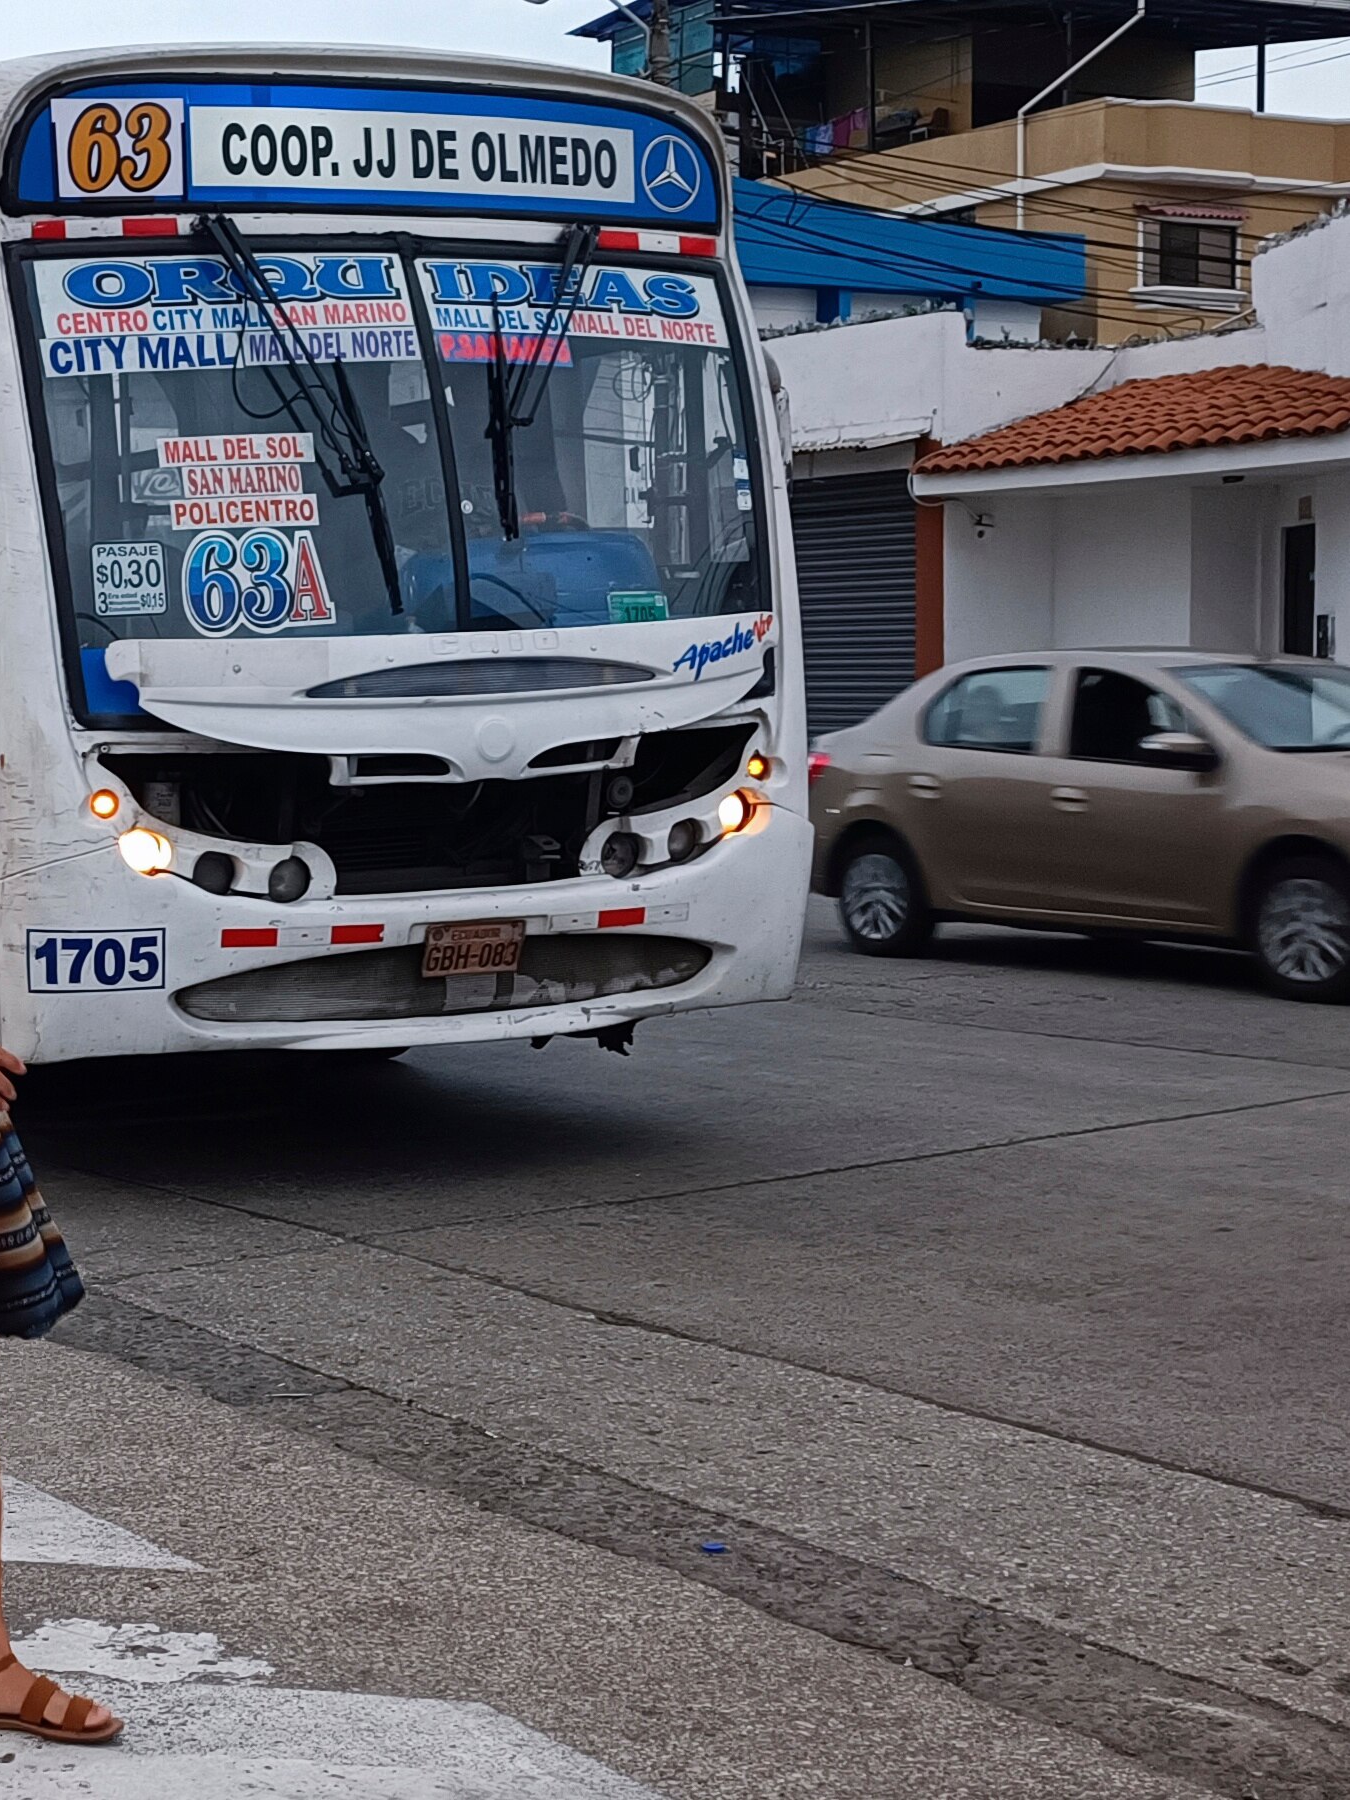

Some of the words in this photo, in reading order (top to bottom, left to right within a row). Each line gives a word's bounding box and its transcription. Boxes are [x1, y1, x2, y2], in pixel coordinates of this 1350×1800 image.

[67, 102, 172, 193] 63
[222, 122, 340, 176] COOP.
[353, 127, 396, 178] JJ
[410, 128, 459, 180] DE
[471, 131, 617, 189] OLMEDO
[62, 256, 402, 309] ORQU
[423, 262, 699, 319] IDEAS
[57, 310, 149, 335] CENTRO
[152, 308, 203, 331] CITY
[212, 305, 272, 329] MALL
[274, 304, 318, 327] SAN
[323, 302, 407, 325] MARINO
[435, 307, 489, 328] MALL
[497, 308, 529, 330] DEL
[571, 313, 620, 335] MALL
[624, 317, 657, 338] DEL
[661, 319, 717, 344] NORTE
[50, 335, 127, 374] CITY
[138, 333, 236, 369] MALL
[308, 331, 346, 360] DEL
[352, 330, 416, 359] NORTE
[164, 439, 218, 464] MALL
[222, 437, 261, 460] DEL
[266, 436, 304, 459] SOL
[187, 467, 225, 496] SAN
[228, 465, 301, 494] MARINO
[174, 498, 314, 526] POLICENTRO
[96, 545, 159, 557] PASAJE
[96, 558, 161, 589] $0,30
[186, 534, 332, 632] 63A
[98, 591, 109, 614] 3
[673, 621, 754, 681] Apache
[35, 936, 159, 985] 1705
[426, 941, 519, 972] GBH-083
